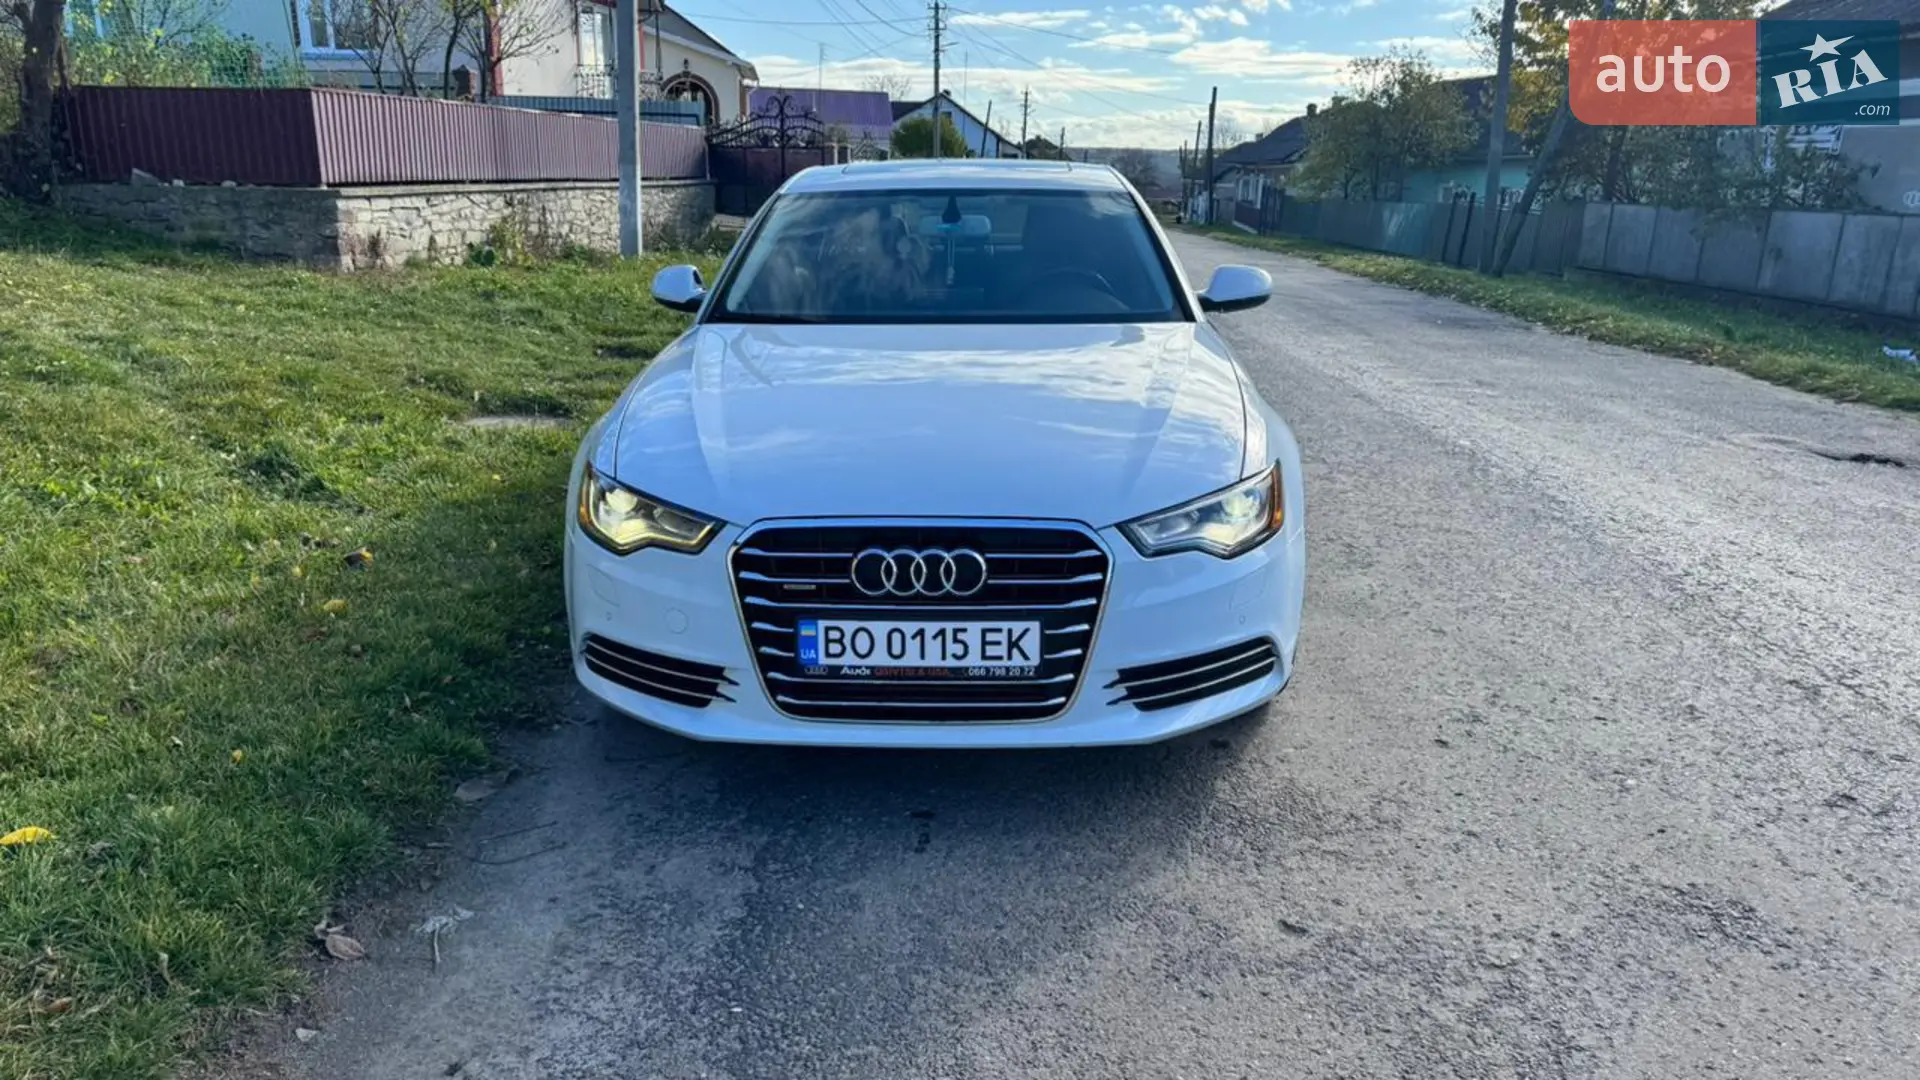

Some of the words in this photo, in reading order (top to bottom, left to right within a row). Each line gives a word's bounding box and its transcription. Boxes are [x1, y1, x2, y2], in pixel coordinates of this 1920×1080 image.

[823, 625, 876, 659] BO
[886, 627, 969, 661] 0115
[980, 627, 1032, 661] EK
[800, 649, 817, 660] UA
[840, 665, 871, 676] Audi
